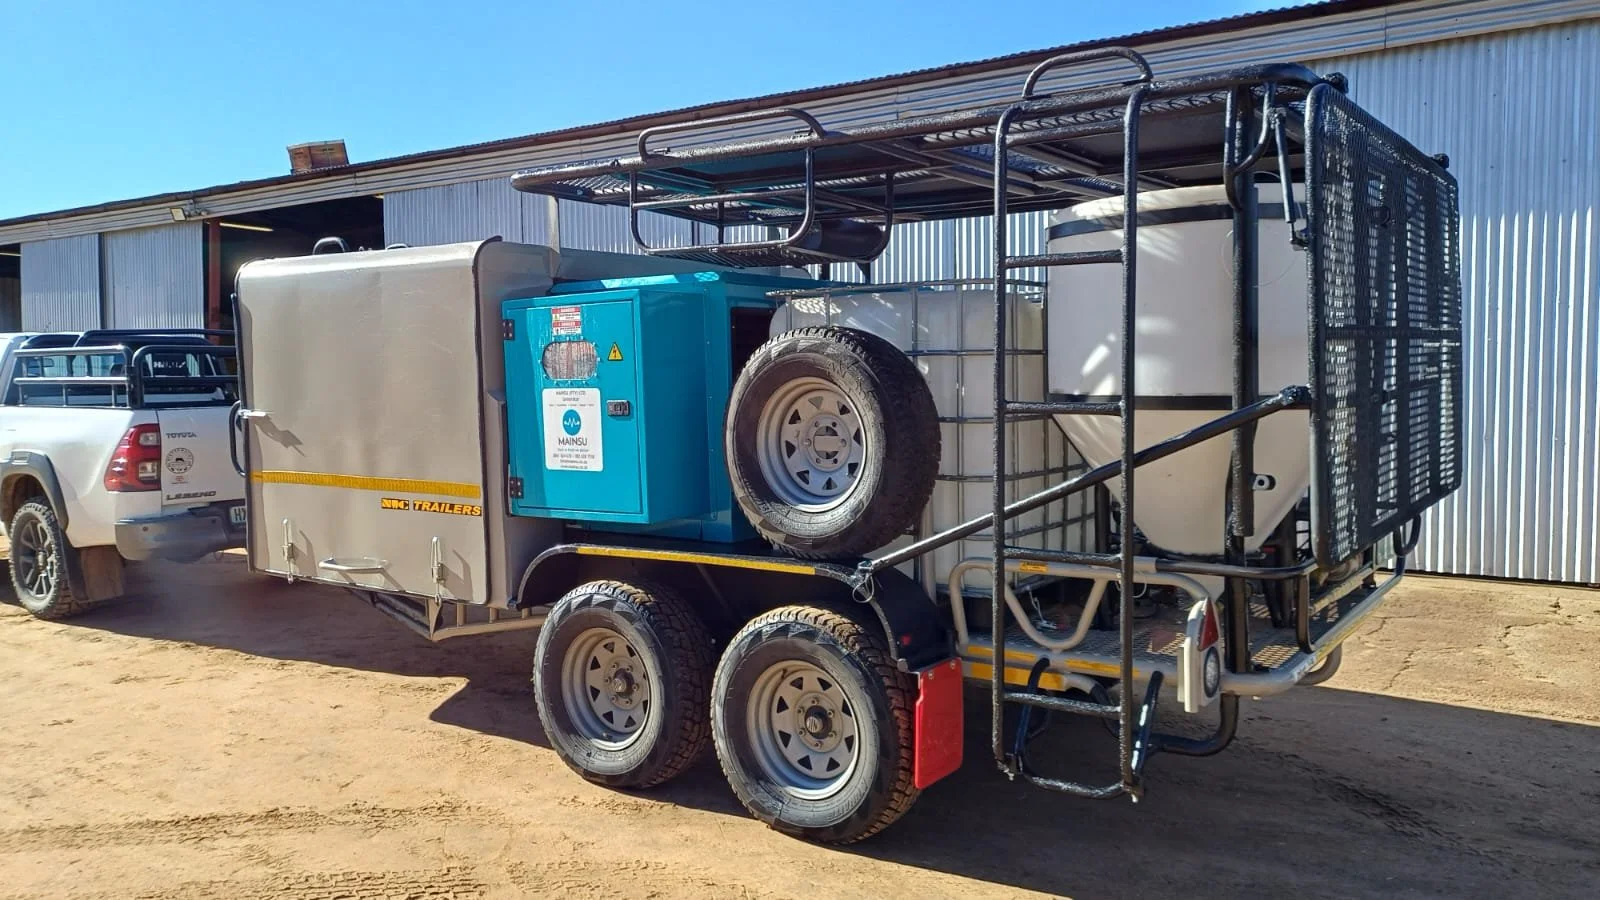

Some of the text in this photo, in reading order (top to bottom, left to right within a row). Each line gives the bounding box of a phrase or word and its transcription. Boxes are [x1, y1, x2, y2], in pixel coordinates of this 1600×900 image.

[558, 437, 588, 446] MAINSU
[166, 491, 216, 501] LEGEND
[413, 500, 482, 516] TRAILERS
